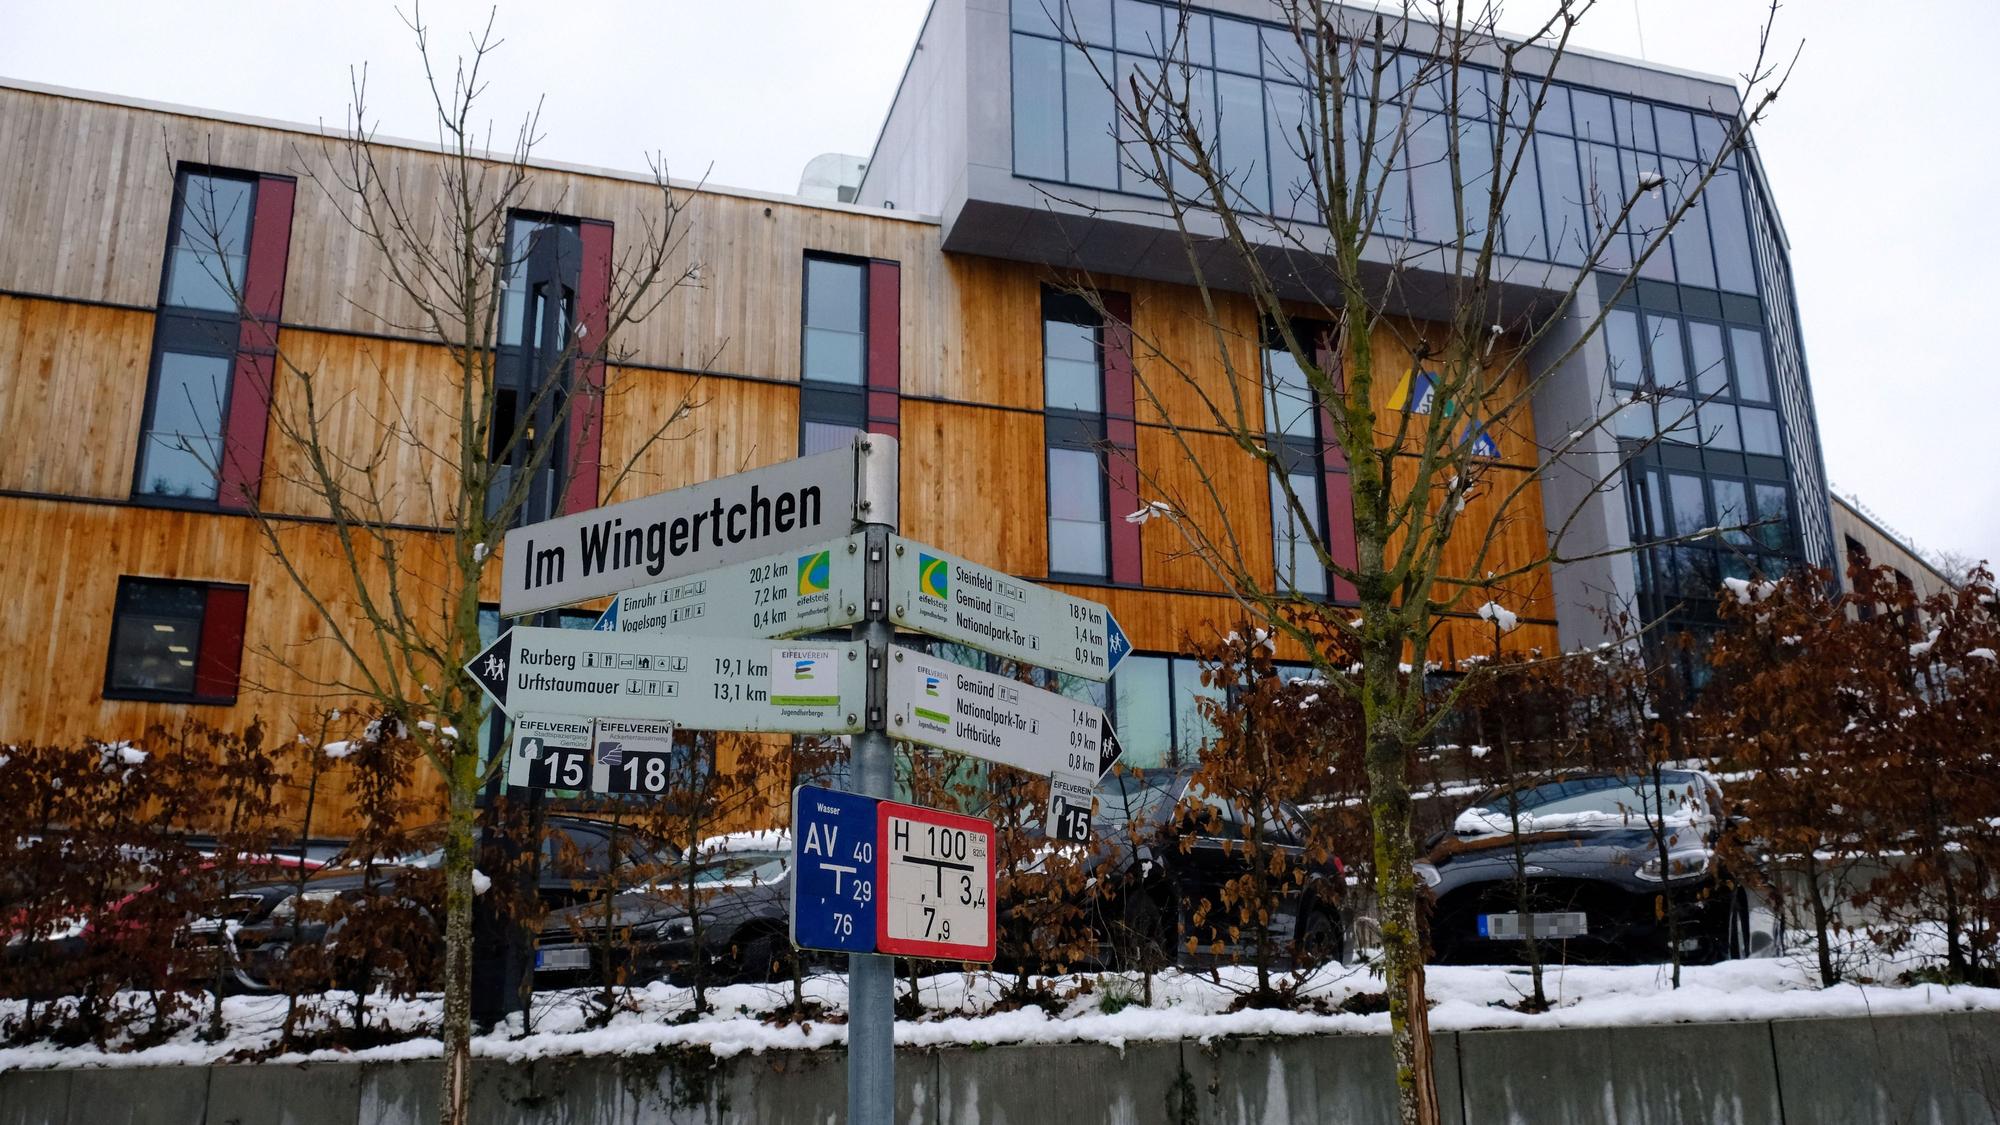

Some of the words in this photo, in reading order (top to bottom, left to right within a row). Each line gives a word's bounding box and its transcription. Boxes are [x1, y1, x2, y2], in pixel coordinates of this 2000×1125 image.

[524, 539, 565, 590] Im
[580, 484, 821, 576] Wingertchen
[623, 592, 657, 611] Einruhr
[749, 566, 771, 584] 20,2
[772, 563, 788, 578] km
[797, 593, 829, 606] eifelsteig
[956, 566, 992, 592] Steinfeld
[1069, 603, 1087, 623] 18,9
[1089, 607, 1102, 625] km
[622, 613, 667, 632] Vogelsang
[754, 590, 771, 606] 7,2
[771, 586, 787, 600] km
[919, 595, 948, 612] eifelsteig
[956, 591, 991, 613] Gemünd
[1075, 626, 1087, 643] 1,4
[1089, 630, 1103, 646] km
[753, 613, 770, 629] 0,4
[771, 610, 787, 625] km
[956, 612, 1026, 647] Nationalpark-Tor
[1075, 647, 1088, 664] 0,9
[1090, 651, 1104, 667] km
[520, 649, 576, 670] Rurberg
[715, 658, 743, 676] 19,1
[747, 660, 768, 677] km
[782, 651, 829, 659] EIFELVEREIN
[518, 673, 619, 695] Urftstaumauer
[713, 683, 742, 702] 13,1
[746, 684, 767, 702] km
[917, 665, 949, 681] EIFELVEREIN
[957, 674, 994, 698] Gemünd
[1072, 708, 1084, 728] 1,4
[1085, 713, 1097, 729] km
[520, 720, 589, 734] EIFELVEREIN
[534, 730, 588, 741] Stadtspaziergang
[601, 722, 669, 734] EIFELVEREIN
[957, 698, 1027, 731] Nationalpark-Tor
[1070, 732, 1082, 748] 0,9
[1084, 735, 1096, 751] km
[560, 739, 587, 748] Gemünd
[956, 722, 1001, 747] Urftbrücke
[1068, 753, 1080, 772] 0,8
[1082, 756, 1095, 772] km
[544, 752, 585, 786] 15
[623, 757, 666, 792] 18
[1054, 780, 1092, 795] EIFELVEREIN
[816, 802, 841, 816] Wasser
[894, 819, 909, 852] H
[928, 826, 966, 861] 100
[1066, 810, 1089, 840] 15
[803, 821, 838, 858] AV
[853, 841, 872, 864] 40
